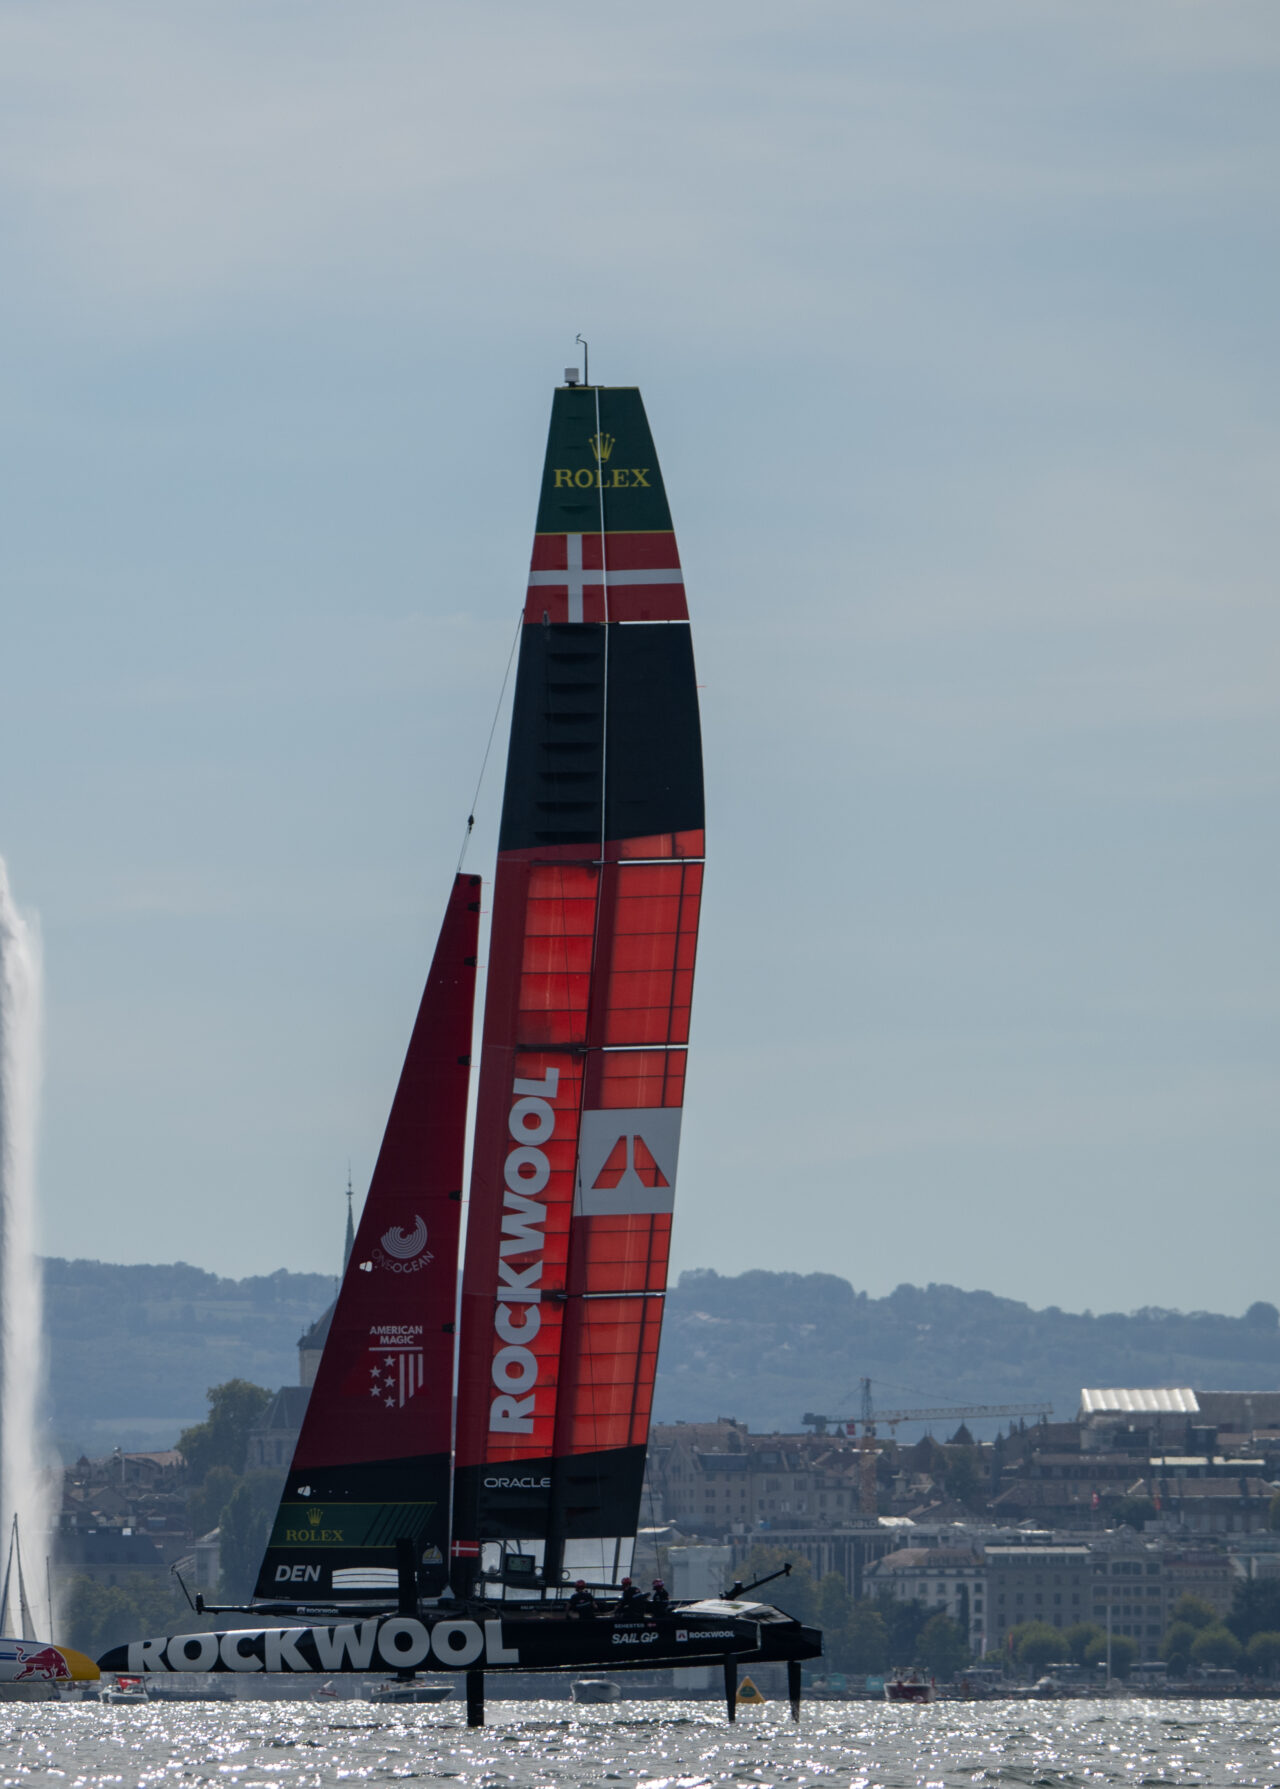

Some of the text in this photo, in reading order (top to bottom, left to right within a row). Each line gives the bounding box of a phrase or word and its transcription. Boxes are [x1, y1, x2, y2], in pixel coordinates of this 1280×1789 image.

[554, 468, 651, 488] ROLEX
[488, 1067, 559, 1434] ROCKWOOL
[369, 1325, 423, 1335] AMERICAN
[380, 1335, 414, 1345] MAGIC
[483, 1477, 551, 1489] ORACLE
[286, 1529, 344, 1542] ROLEX
[274, 1565, 321, 1582] DEN
[688, 1630, 735, 1639] ROCKWOOL
[128, 1616, 520, 1673] ROCKWOOL
